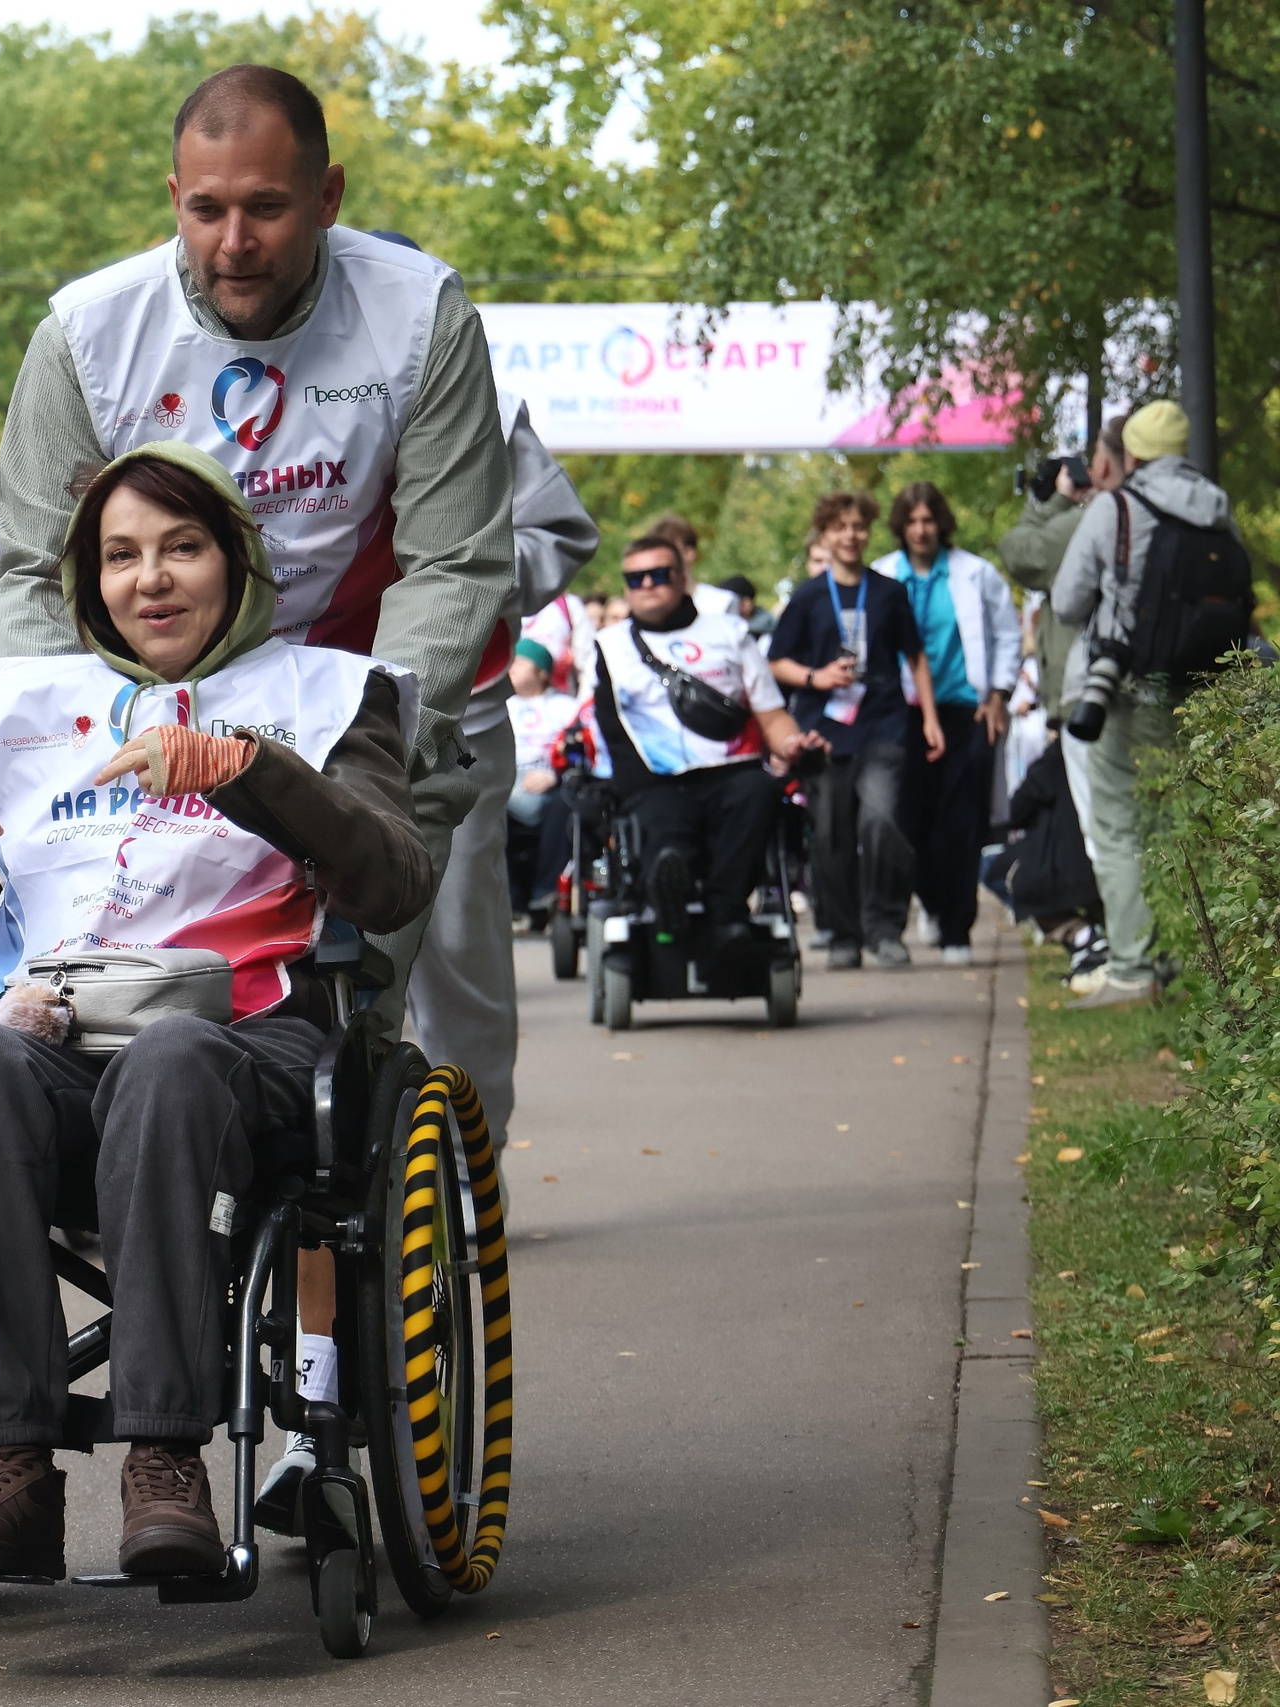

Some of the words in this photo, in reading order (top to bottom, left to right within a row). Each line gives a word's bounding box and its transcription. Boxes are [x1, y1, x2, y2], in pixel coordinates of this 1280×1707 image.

[488, 343, 590, 371] ТАРТ
[252, 494, 349, 515] ФЕСТИВАЛЬ
[272, 564, 318, 577] ЛЬНЫЙ
[51, 789, 97, 822] НА
[46, 822, 132, 845] СПОРТИВН
[131, 812, 229, 839] ФЕСТИВАЛЬ
